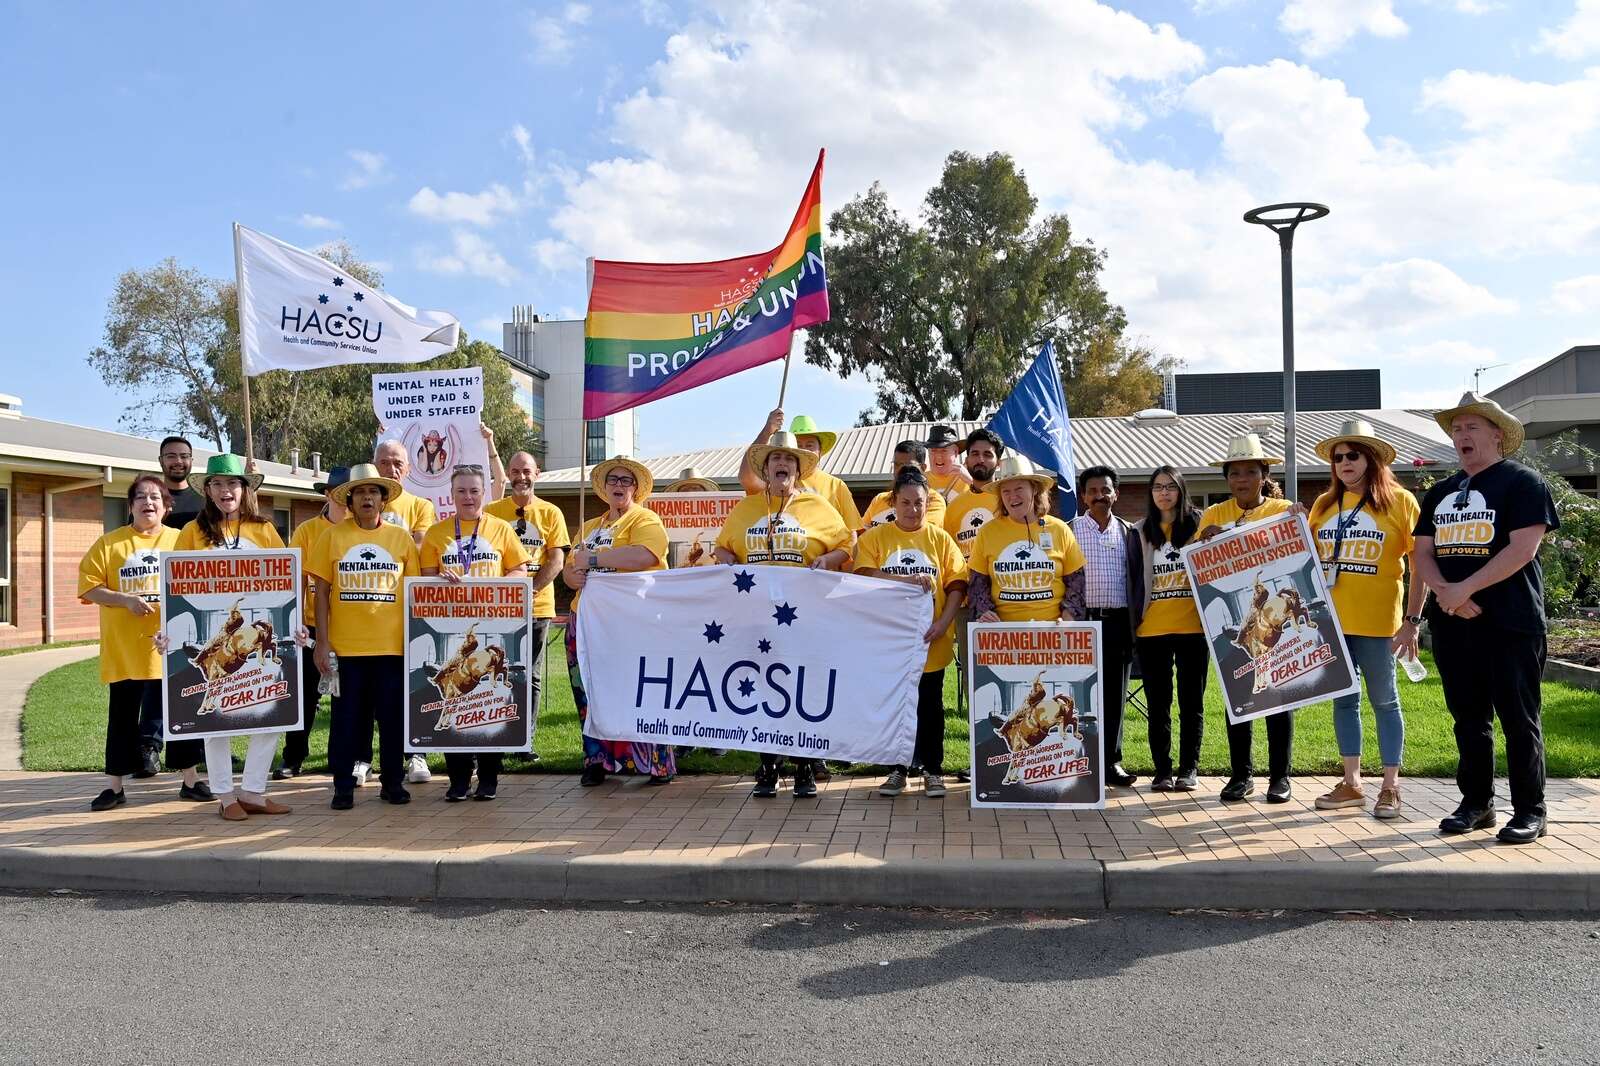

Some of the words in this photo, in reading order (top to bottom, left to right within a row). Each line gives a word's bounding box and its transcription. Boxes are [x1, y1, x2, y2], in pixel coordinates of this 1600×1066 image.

[281, 305, 382, 343] HACSU
[283, 334, 300, 345] Health
[300, 335, 310, 346] and
[310, 336, 339, 350] Community
[340, 341, 361, 353] Services
[361, 343, 378, 355] Union
[378, 380, 424, 391] MENTAL
[430, 376, 480, 388] HEALTH?
[388, 395, 425, 405] UNDER
[431, 393, 456, 402] PAID
[463, 391, 470, 400] &
[385, 408, 422, 419] UNDER
[428, 405, 476, 417] STAFFED
[647, 500, 716, 516] WRANGLING
[680, 517, 709, 528] HEALTH
[711, 516, 727, 528] SYS
[1434, 513, 1459, 525] ENTAL
[1460, 511, 1493, 522] HEALTH
[777, 526, 806, 535] HEALTH
[957, 529, 977, 541] MENTAL
[1349, 529, 1384, 541] HEALTH
[1436, 522, 1494, 545] NITED
[520, 538, 544, 546] HEALTH
[747, 533, 807, 551] UNTED
[1191, 527, 1270, 570] WRANGLING
[1269, 519, 1300, 542] THE
[471, 552, 499, 561] HEALTH
[774, 553, 803, 562] POWER
[1450, 547, 1490, 555] POWER
[170, 558, 260, 580] WRANGLING
[264, 558, 292, 577] THE
[338, 561, 369, 572] MENTAL
[370, 562, 399, 572] HEALTH
[994, 561, 1023, 572] MENTAL
[1025, 561, 1054, 571] HEALTH
[1152, 563, 1174, 575] ENTAL
[1197, 563, 1233, 584] MENTAL
[1232, 552, 1268, 574] HEALTH
[1267, 539, 1306, 561] SYSTEM
[1340, 564, 1377, 574] POWER
[120, 565, 152, 578] MENTAL
[881, 566, 909, 576] MENTAL
[909, 565, 937, 577] HEALTH
[995, 571, 1055, 588] UNITED
[171, 581, 212, 595] MENTAL
[214, 579, 250, 593] HEALTH
[253, 578, 292, 592] SYSTEM
[339, 572, 398, 590] UNITED
[366, 593, 395, 601] POWER
[413, 586, 494, 604] WRANGLING
[497, 586, 523, 604] THE
[1000, 592, 1022, 600] UNION
[1023, 591, 1053, 600] POWER
[413, 606, 449, 618] MENTAL
[452, 606, 485, 618] HEALTH
[487, 606, 523, 618] SYSTEM
[977, 631, 1061, 650] WRANGLING
[1064, 631, 1092, 649] THE
[977, 652, 1016, 665] MENTAL
[1018, 652, 1052, 665] HEALTH
[1054, 652, 1093, 665] SYSTEM
[1234, 662, 1255, 679] MENTAL
[1254, 650, 1275, 668] HEALTH
[1275, 636, 1301, 653] WORKERS
[1257, 664, 1269, 675] ARE
[1269, 650, 1294, 669] HOLDING
[1293, 645, 1302, 655] ON
[1302, 639, 1313, 651] FOR
[1270, 660, 1300, 683] DEAR
[1303, 644, 1332, 668] LIFE!
[181, 683, 207, 696] MENTAL
[208, 677, 233, 688] HEALTH
[233, 668, 262, 681] WORKERS
[208, 688, 222, 698] ARE
[223, 682, 250, 693] HOLDING
[262, 674, 273, 682] FOR
[635, 655, 837, 723] HACSU
[221, 689, 254, 708] DEAR
[257, 682, 288, 700] LIFE!
[421, 700, 444, 712] MENTAL
[444, 696, 467, 706] HEALTH
[467, 690, 494, 701] WORKERS
[445, 705, 458, 715] ARE
[458, 701, 483, 712] HOLDING
[484, 699, 492, 707] ON
[493, 696, 504, 705] FOR
[455, 709, 486, 726] DEAR
[489, 704, 518, 720] LIFE!
[636, 717, 668, 736] Health
[672, 719, 692, 737] and
[693, 720, 748, 745] Community
[751, 726, 794, 747] Services
[798, 731, 830, 750] Union
[987, 754, 1011, 766] MENTAL
[1012, 748, 1035, 759] HEALTH
[1036, 743, 1064, 754] WORKERS
[1013, 758, 1026, 769] ARE
[1026, 754, 1053, 766] HOLDING
[1054, 752, 1063, 760] ON
[1063, 749, 1075, 758] FOR
[1024, 762, 1056, 780] DEAR
[1058, 758, 1089, 775] LIFE!
